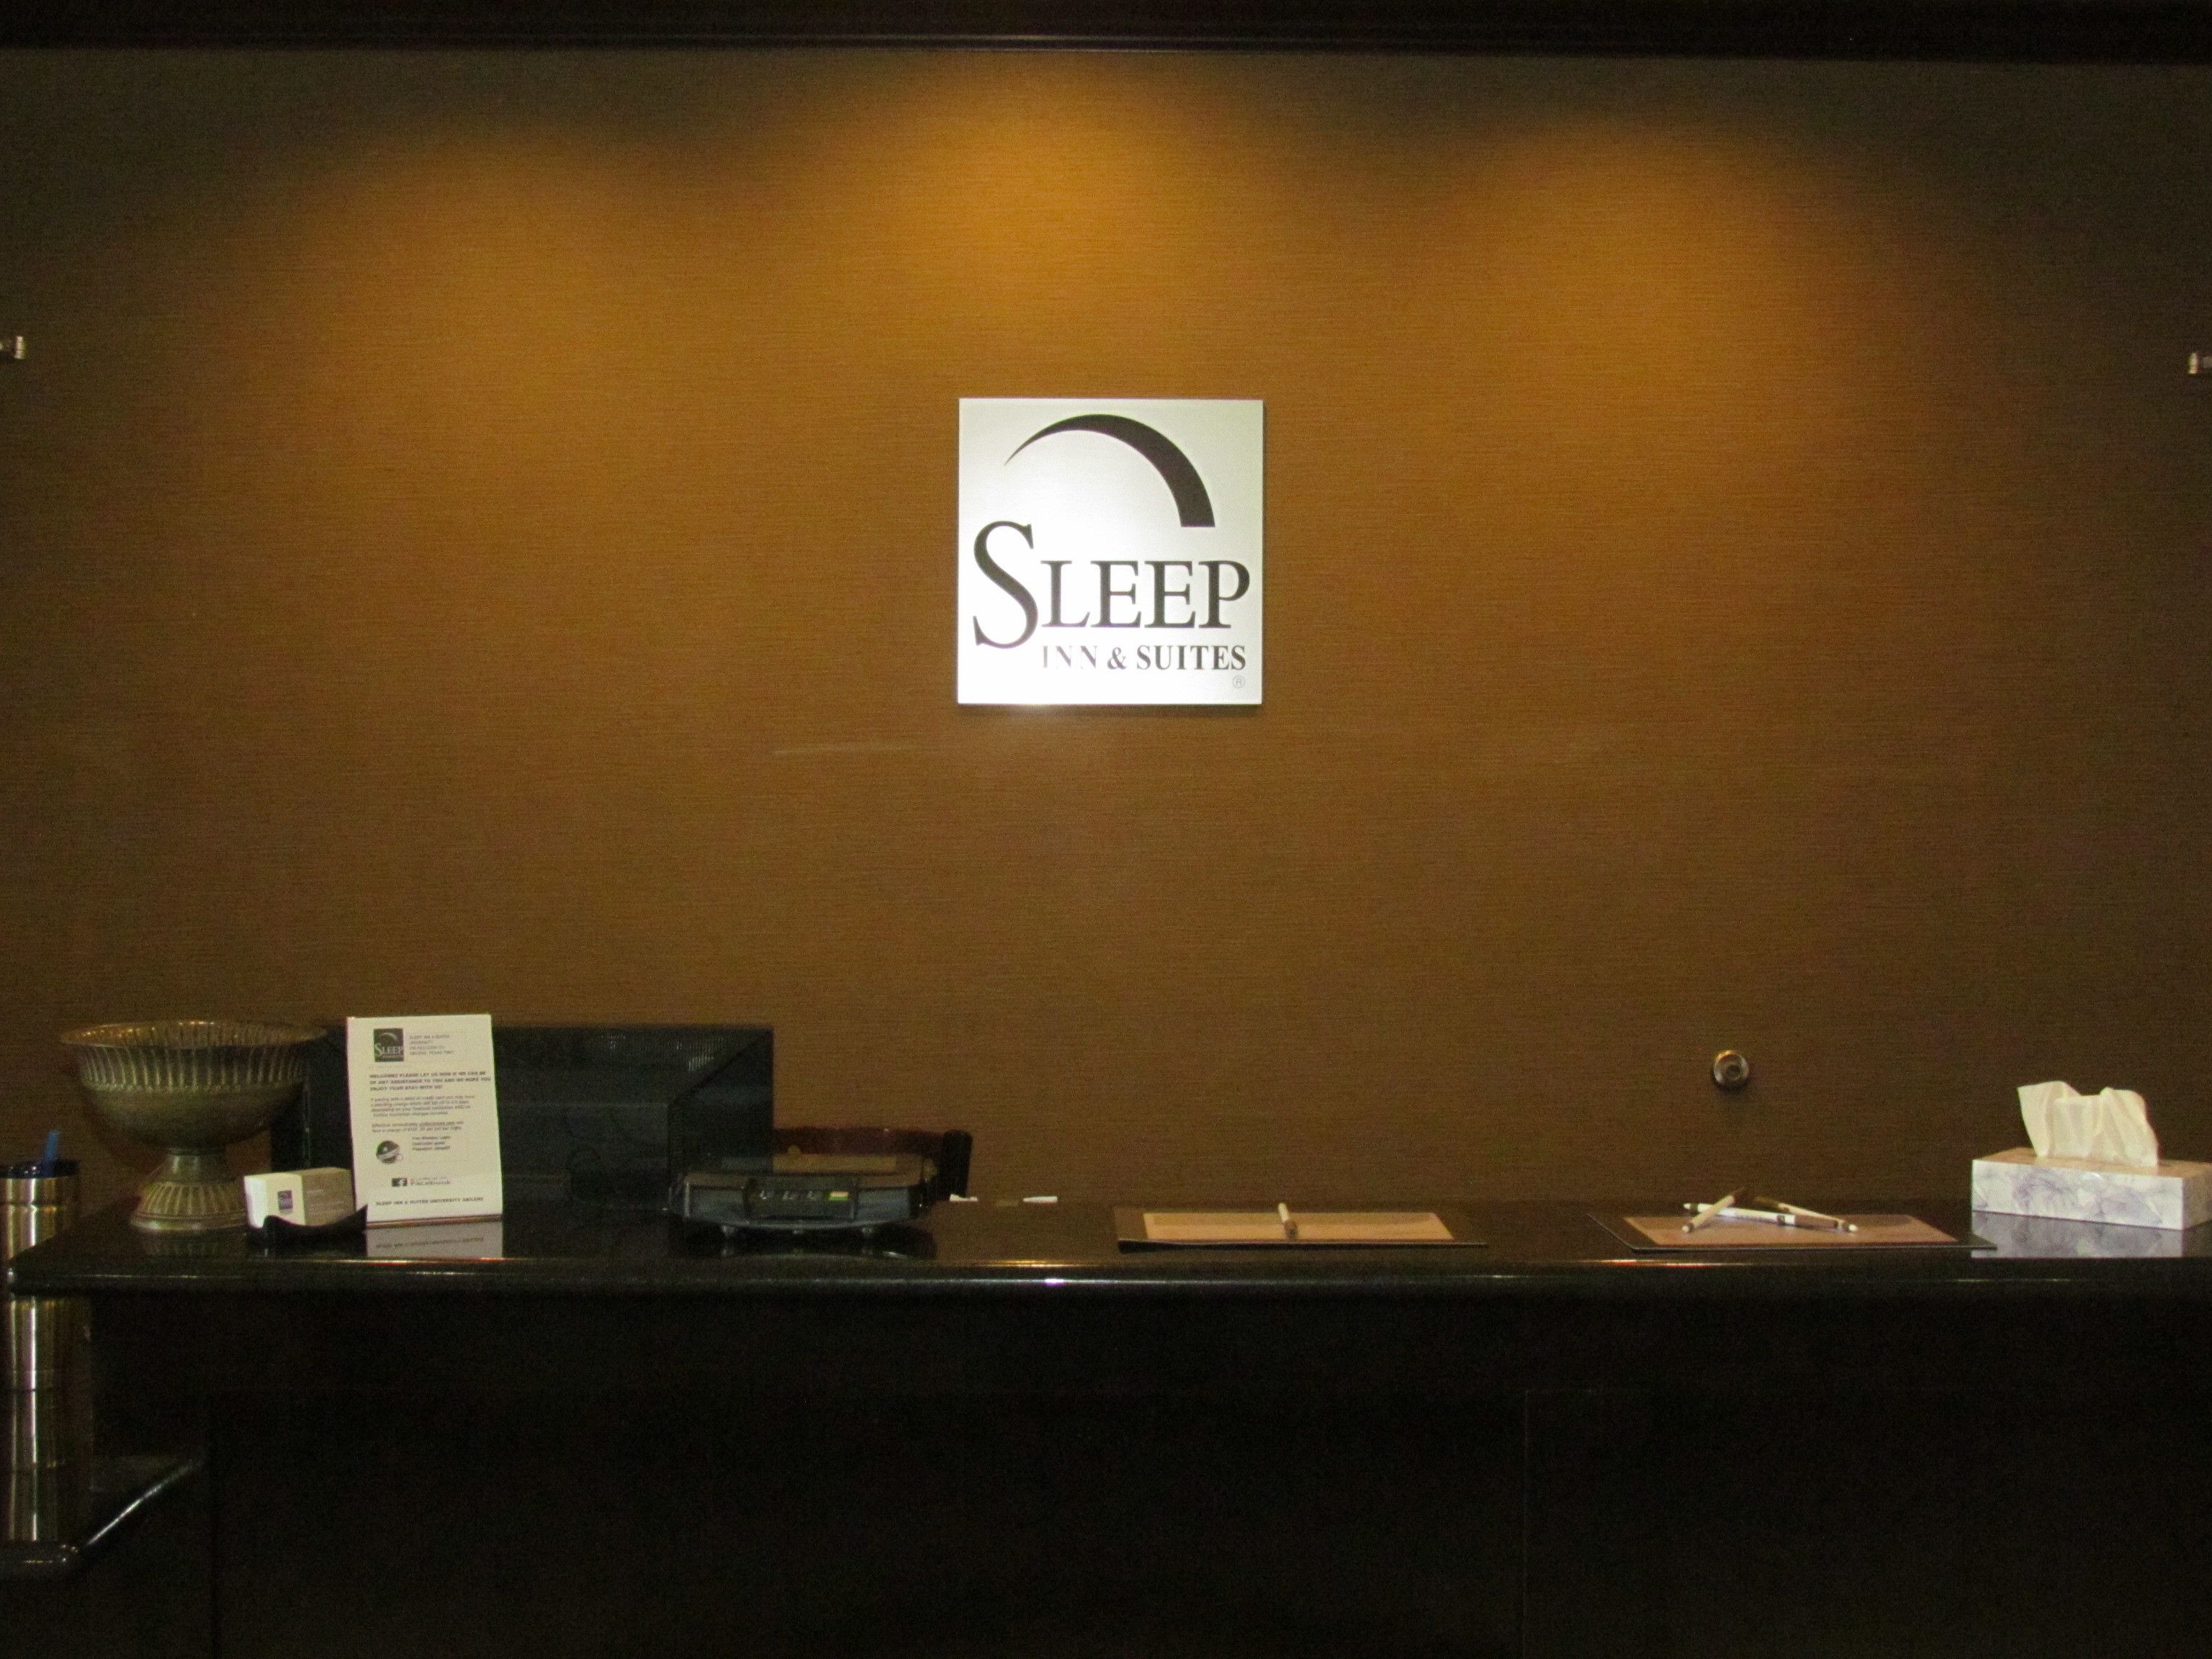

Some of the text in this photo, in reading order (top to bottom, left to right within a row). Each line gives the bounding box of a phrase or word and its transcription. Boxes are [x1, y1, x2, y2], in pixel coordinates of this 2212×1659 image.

[973, 520, 1250, 649] SLEEP
[1042, 644, 1246, 670] INN & SUITES
